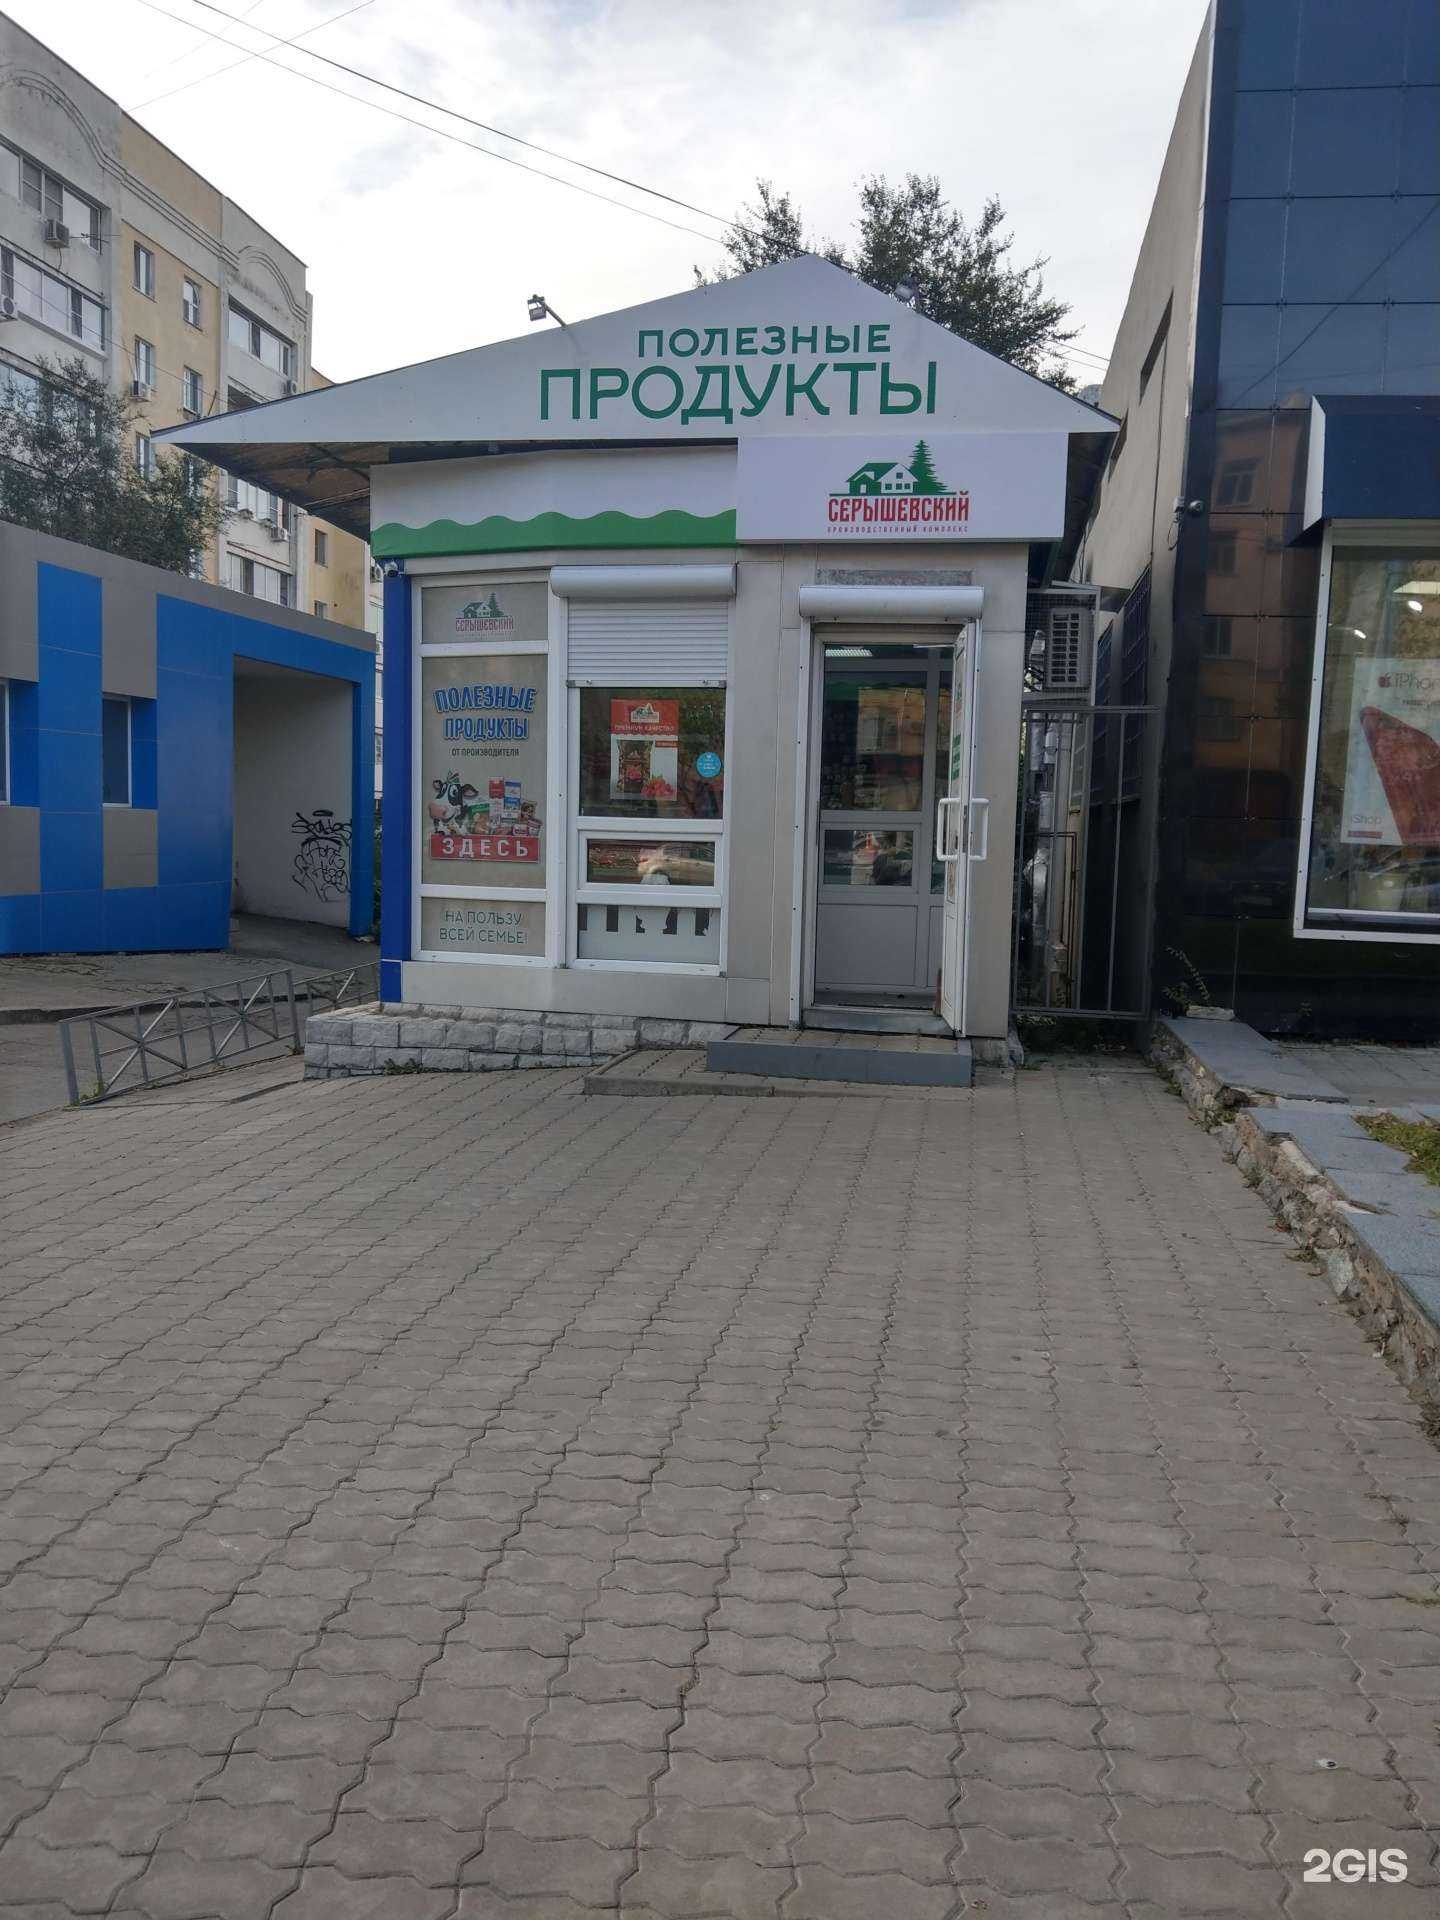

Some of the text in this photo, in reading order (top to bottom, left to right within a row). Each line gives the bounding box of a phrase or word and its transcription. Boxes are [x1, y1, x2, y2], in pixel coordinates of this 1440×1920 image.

[638, 323, 891, 358] ПОЛЕЗНЫЕ
[540, 361, 937, 426] ПРОДУКТЫ
[828, 490, 969, 522] СЕРЫШЕВСКИЙ
[434, 685, 537, 713] ПОЛЕЗНЫЕ
[444, 717, 529, 742] ПРОДУКТЫ
[451, 748, 520, 758] ОТ ПРОИЗВОДИТЕЛЯ
[442, 837, 529, 858] ЗДЕСЬ
[445, 911, 522, 926] НА ПОЛЬЗУ
[439, 926, 475, 941] ВСЕЙ
